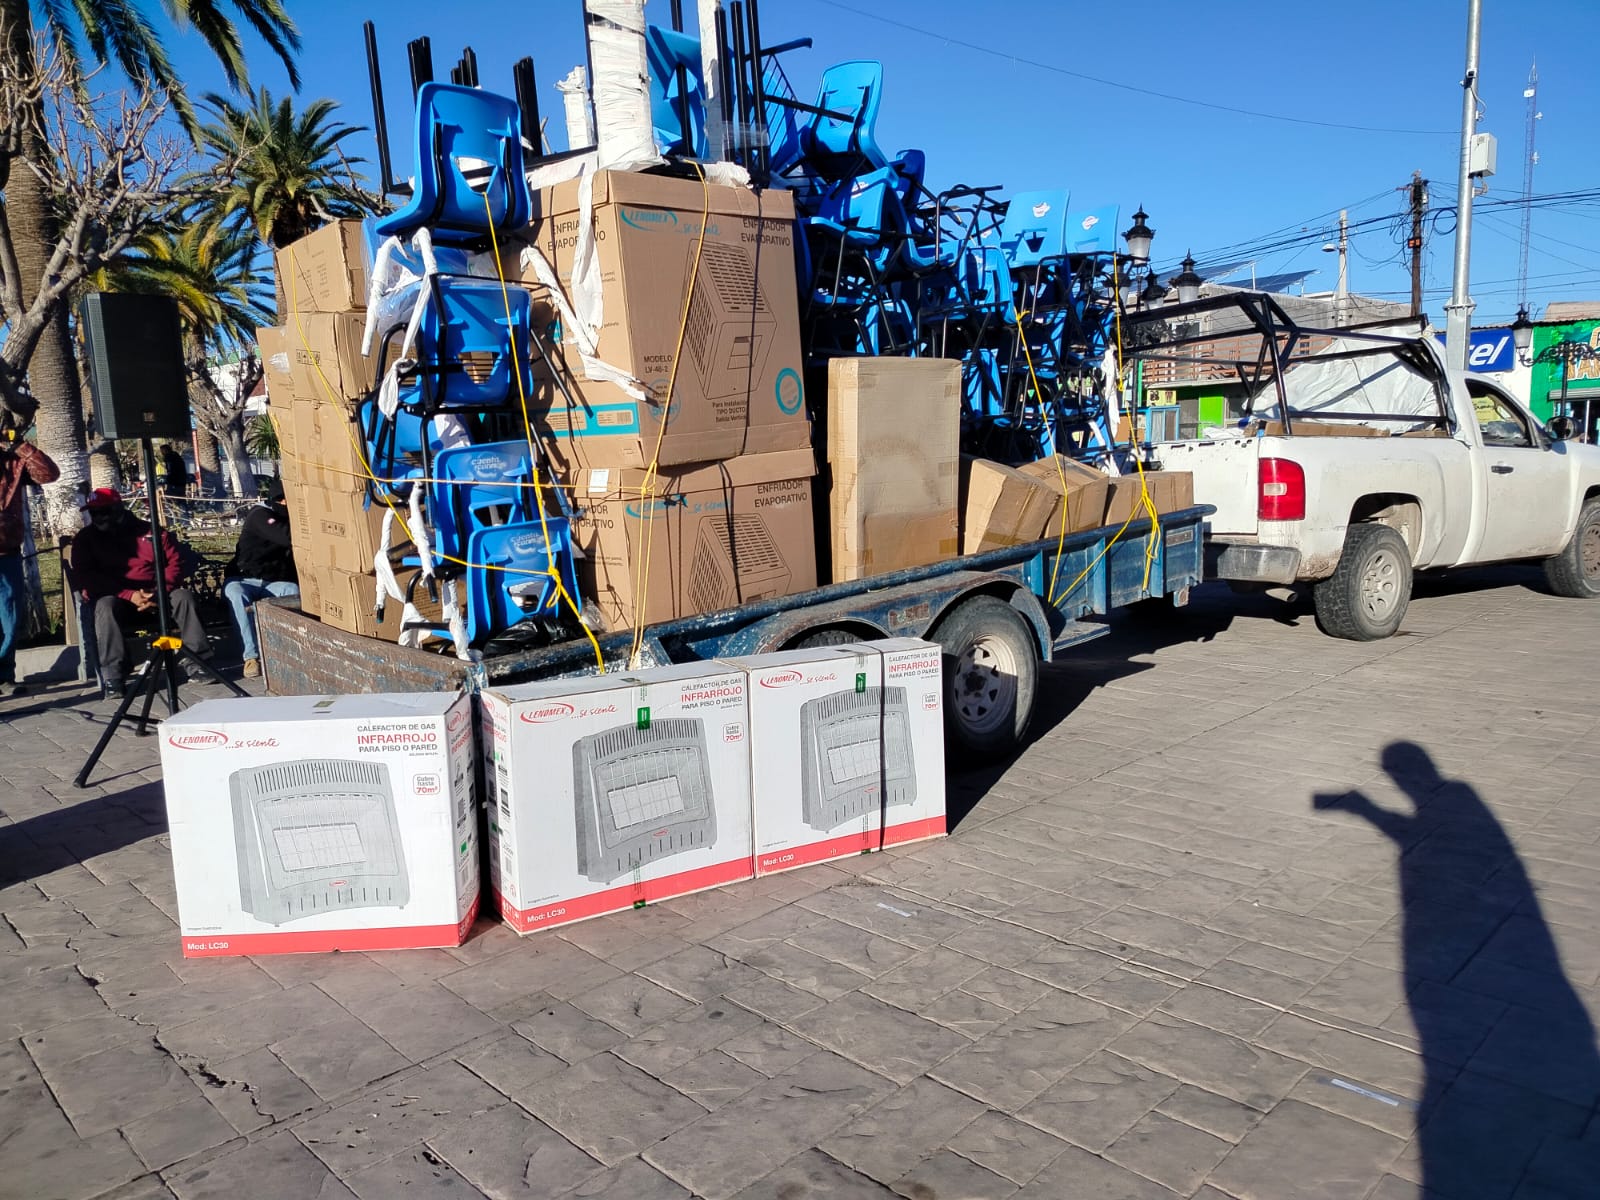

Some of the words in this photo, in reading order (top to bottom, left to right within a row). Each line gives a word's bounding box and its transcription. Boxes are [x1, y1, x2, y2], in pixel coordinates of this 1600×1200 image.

[644, 354, 672, 363] MODELO
[757, 480, 803, 495] ENFRIADOR
[754, 492, 808, 508] EVAPORATIVO
[888, 660, 939, 673] INFRARROJO
[681, 681, 720, 692] CALEFACTOR
[681, 686, 742, 703] INFRARROJO
[681, 703, 699, 711] PARA
[700, 700, 715, 708] PISO
[722, 696, 742, 704] PARED
[529, 707, 567, 719] LENOMEX
[357, 724, 407, 732] CALEFACTOR
[408, 723, 419, 731] DE
[178, 735, 220, 745] LENOMEX
[357, 732, 437, 744] INFRARROJO
[359, 745, 380, 753] PARA
[381, 744, 401, 752] PISO
[410, 743, 438, 751] PARED
[527, 913, 546, 923] Mod:
[546, 907, 566, 918] LC30
[208, 942, 229, 950] LC30
